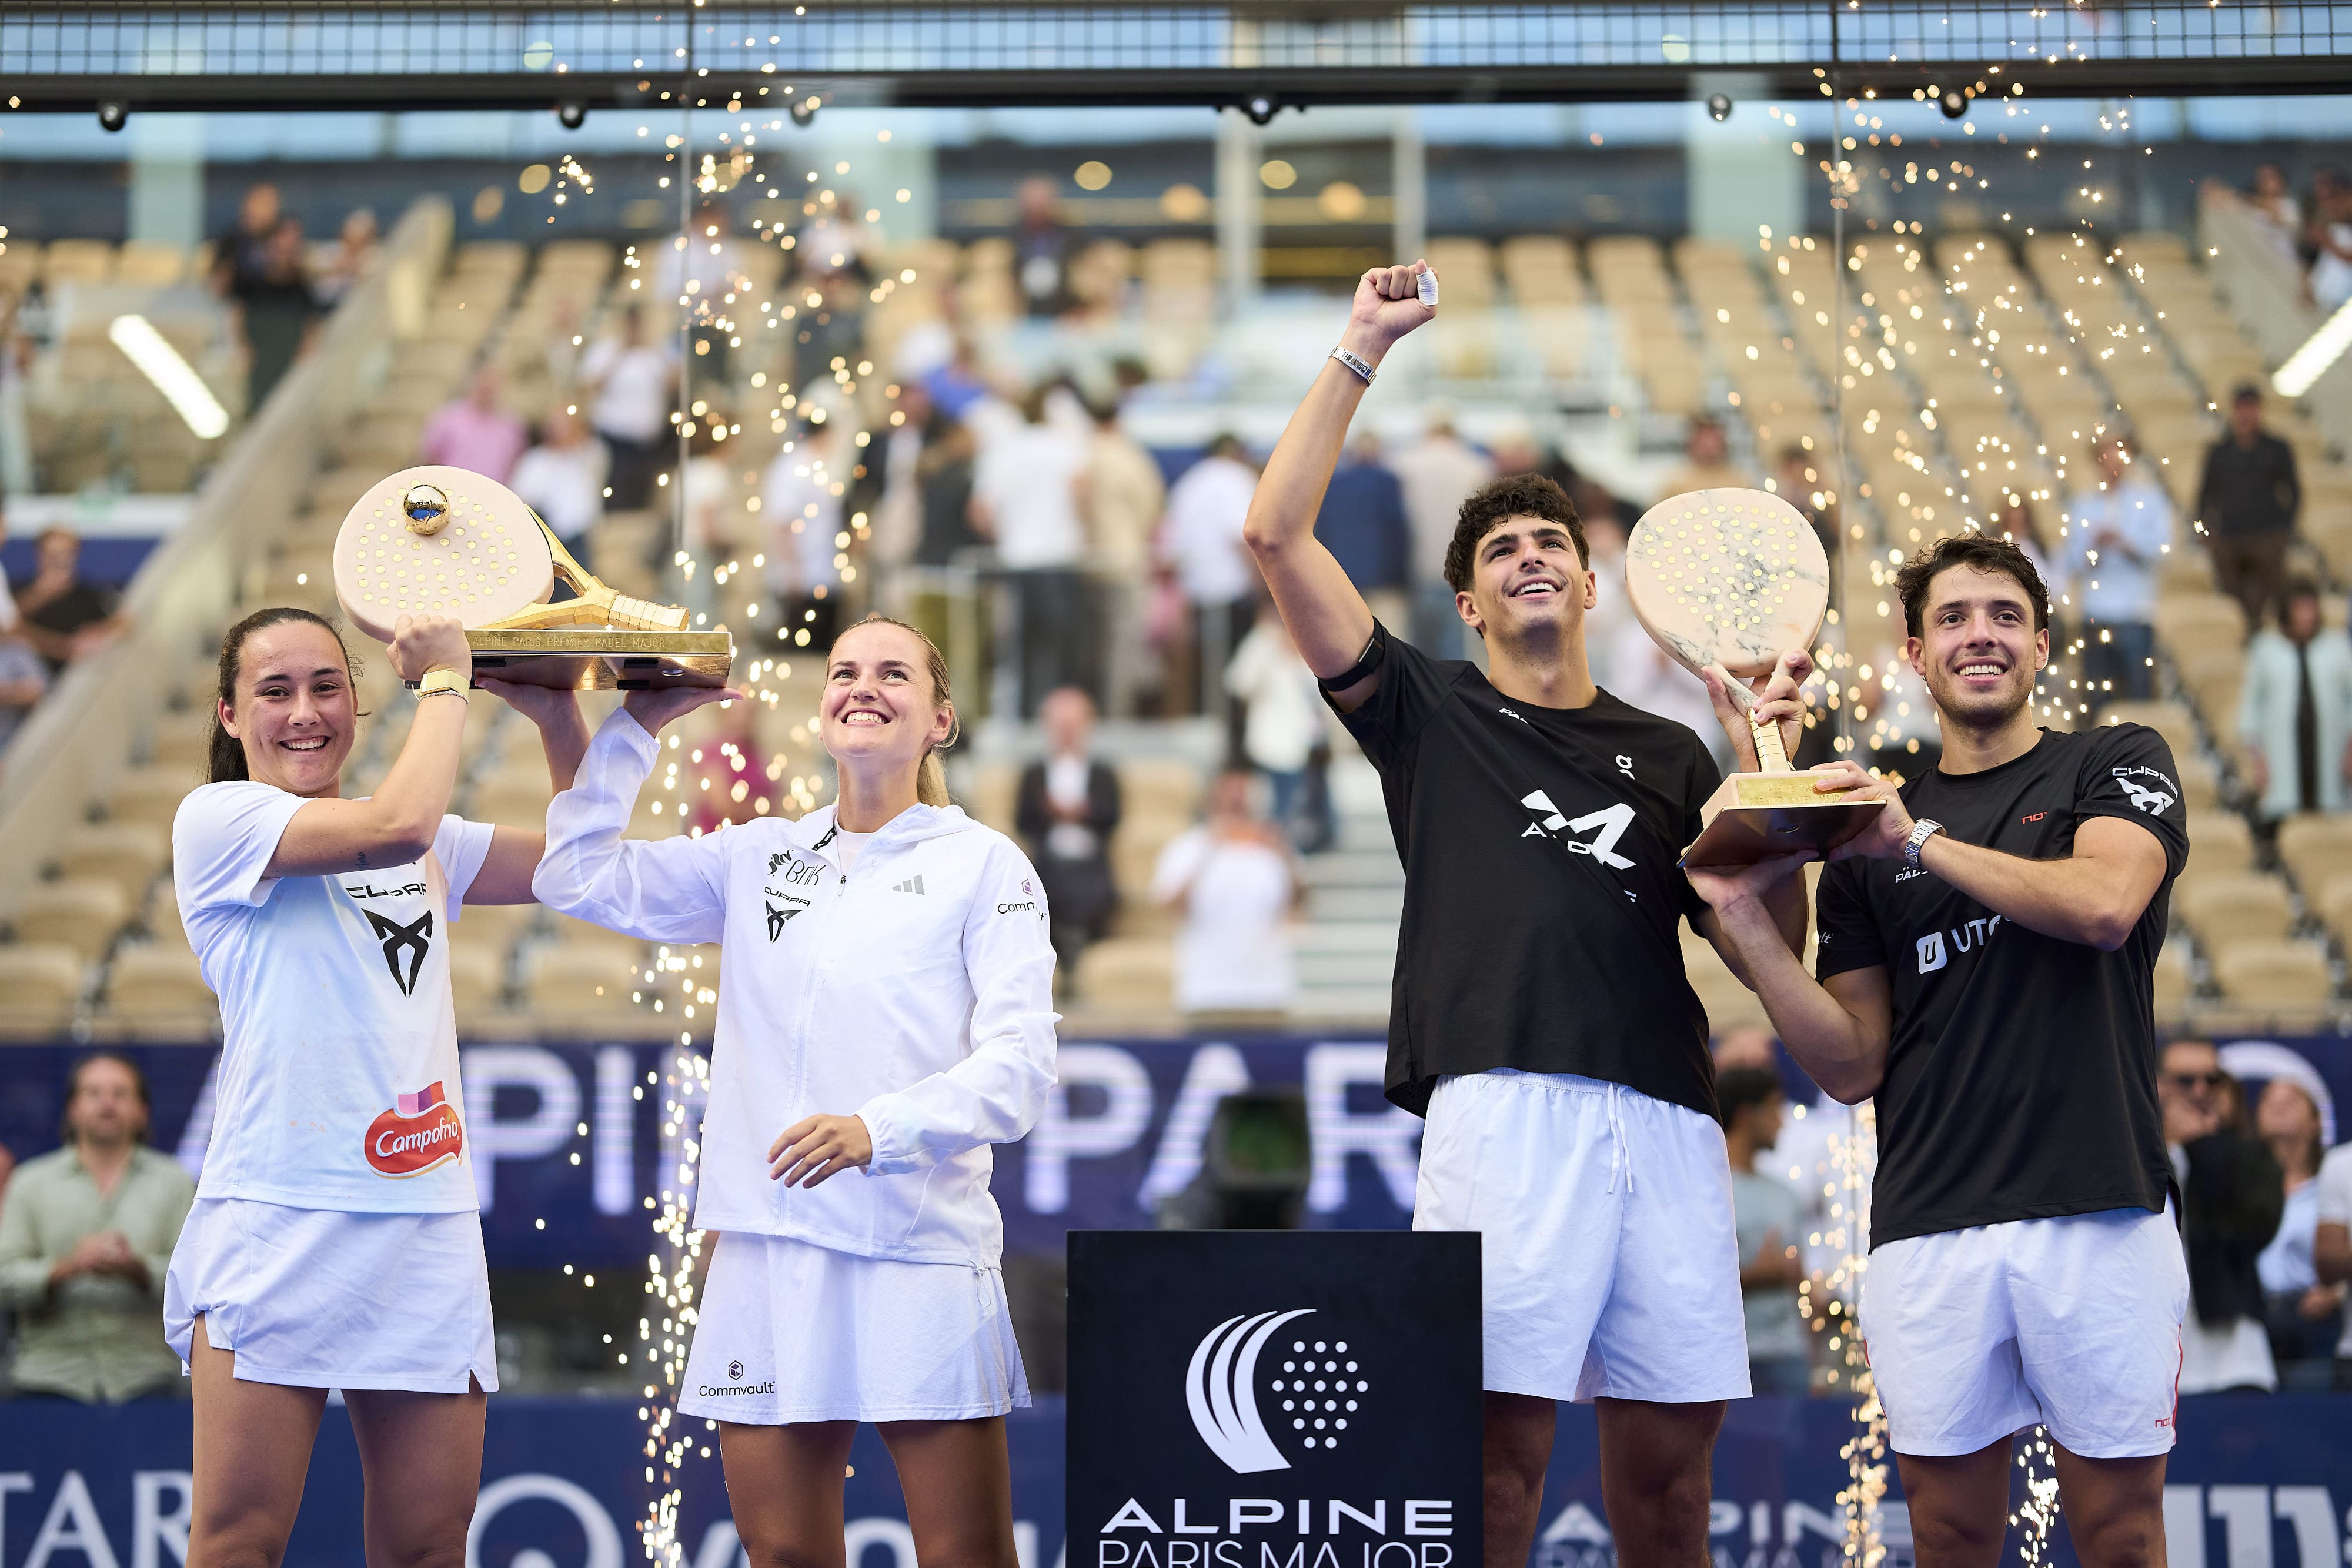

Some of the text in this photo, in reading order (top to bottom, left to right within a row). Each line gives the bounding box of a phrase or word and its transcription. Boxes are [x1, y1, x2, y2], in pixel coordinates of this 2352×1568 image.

[472, 636, 666, 648] ALPINE PARIS PREMIER PADEL MAJOR
[764, 886, 811, 907] CUPRA
[699, 1382, 774, 1396] Commvault
[1100, 1497, 1453, 1536] ALPINE
[1099, 1540, 1244, 1568] PARIS
